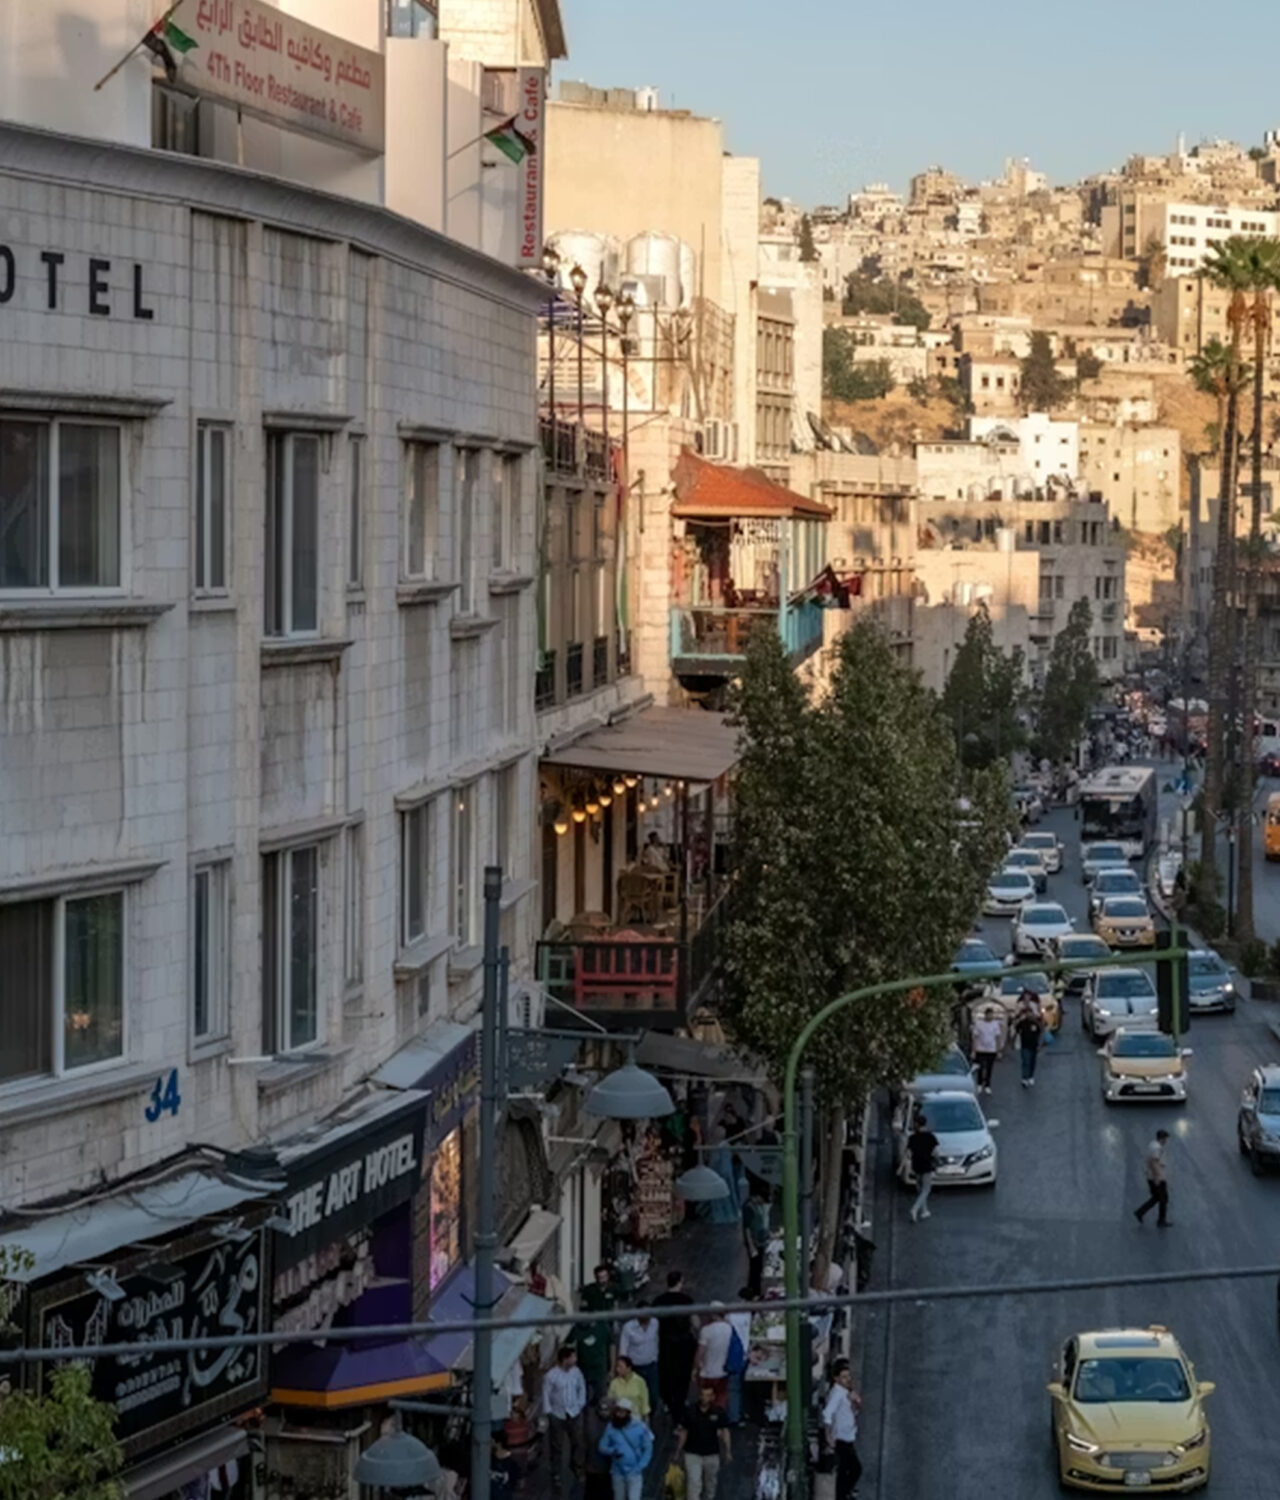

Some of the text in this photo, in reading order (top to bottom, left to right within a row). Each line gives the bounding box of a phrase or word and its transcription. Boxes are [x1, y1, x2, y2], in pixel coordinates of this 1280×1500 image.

[238, 11, 283, 55] الطابق
[207, 51, 231, 83] 4Th
[234, 60, 265, 97] Floor
[267, 74, 327, 120] Restaurant
[329, 98, 337, 123] &
[335, 56, 371, 90] مطعم
[521, 152, 539, 258] Restauran
[145, 1068, 181, 1122] 34
[287, 1134, 417, 1237] THE ART HOTEL
